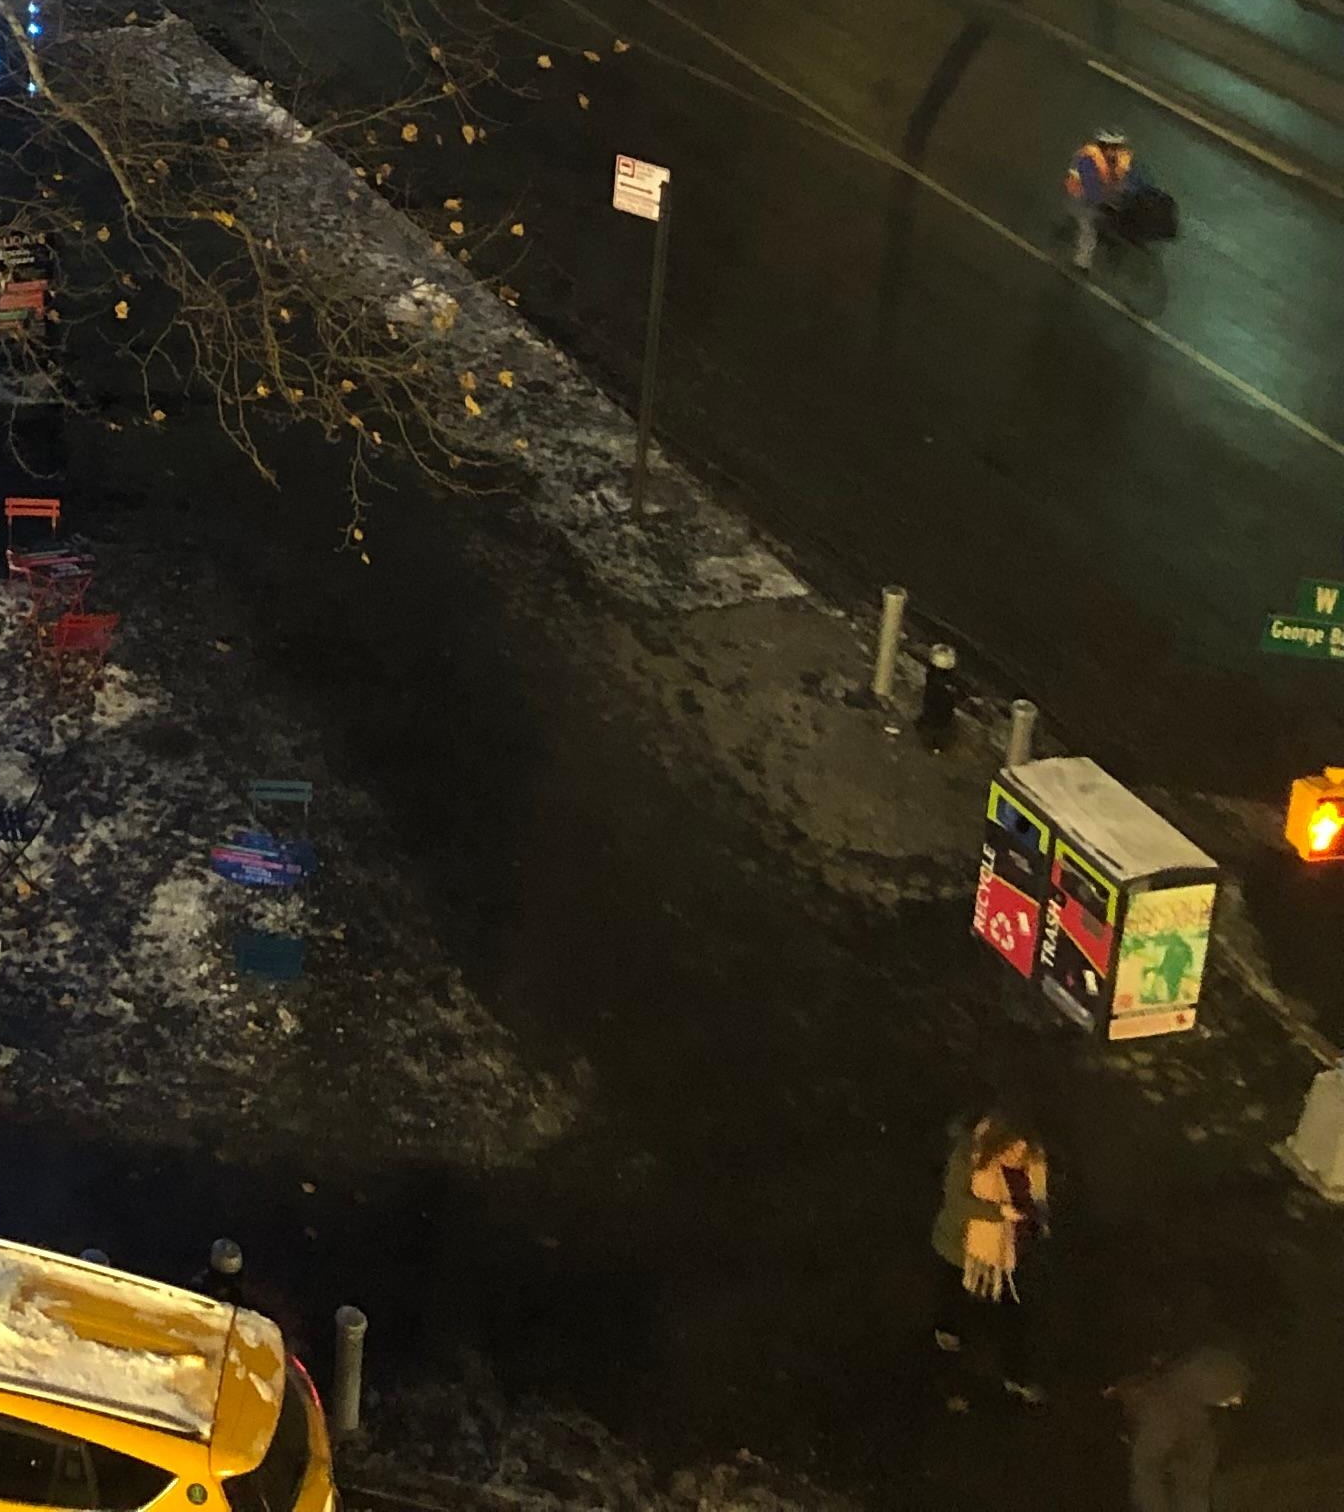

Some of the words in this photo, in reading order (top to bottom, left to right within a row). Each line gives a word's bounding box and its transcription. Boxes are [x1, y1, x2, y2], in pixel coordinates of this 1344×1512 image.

[1316, 586, 1339, 614] W
[1271, 620, 1324, 646] George
[973, 843, 996, 933] RECYCLE
[1040, 899, 1062, 967] TRASH
